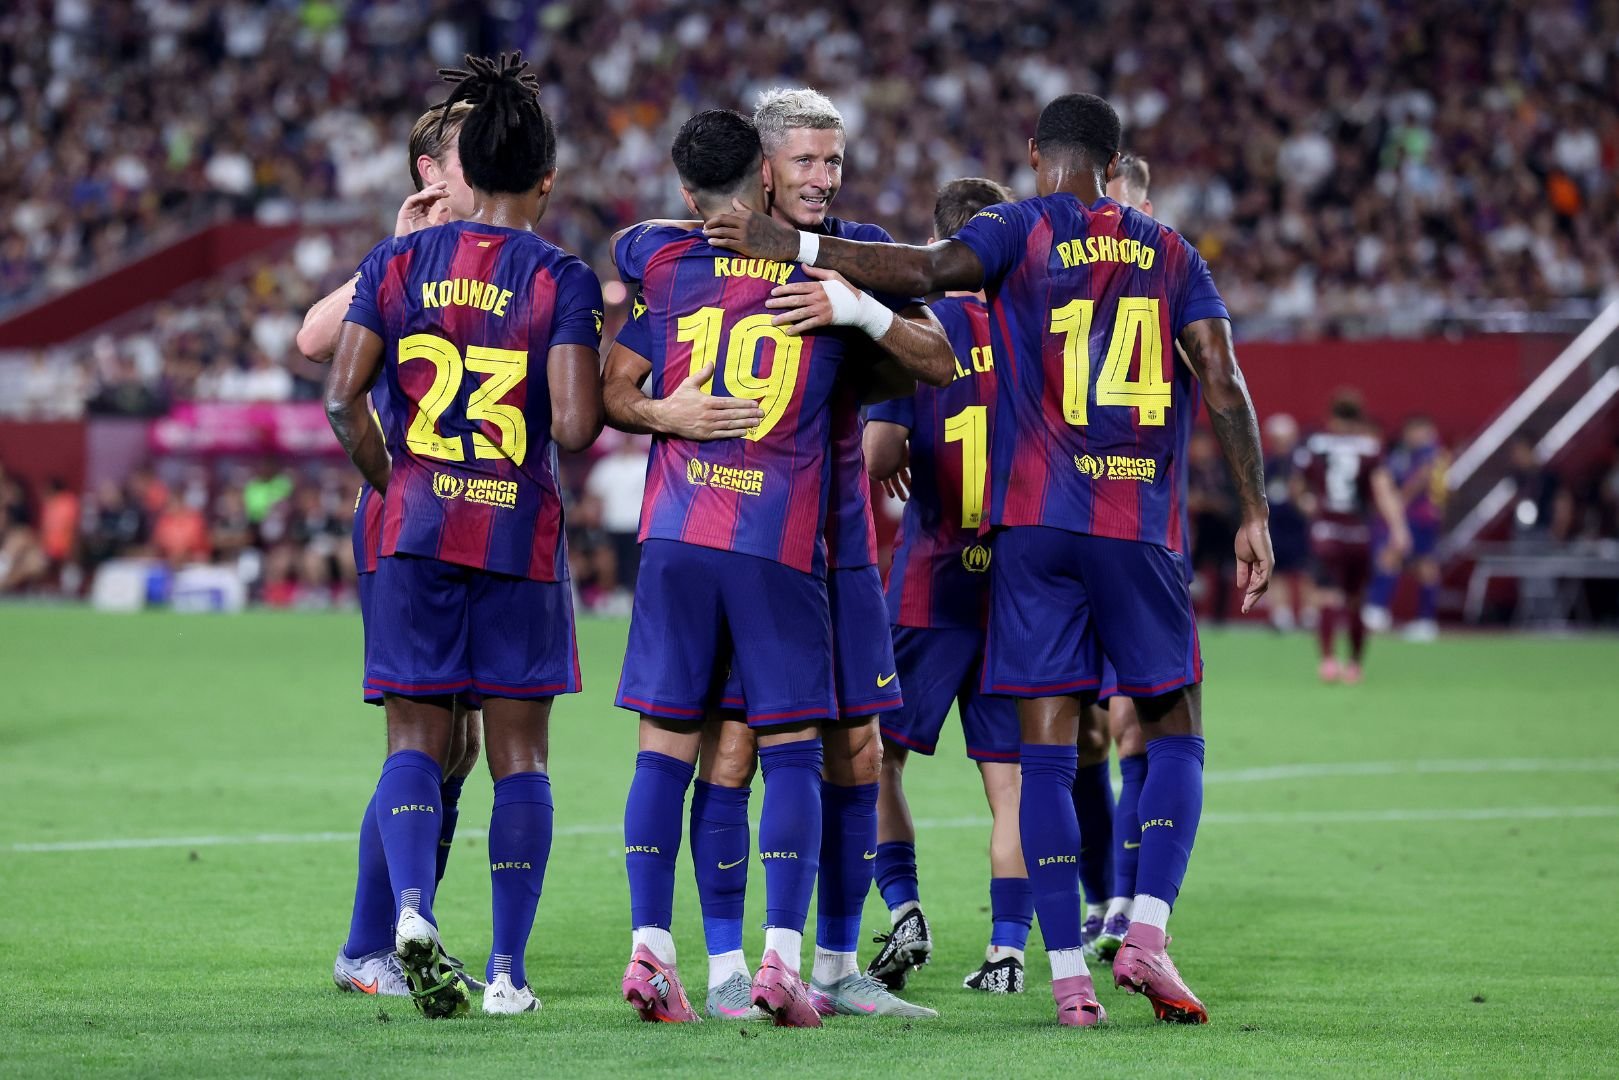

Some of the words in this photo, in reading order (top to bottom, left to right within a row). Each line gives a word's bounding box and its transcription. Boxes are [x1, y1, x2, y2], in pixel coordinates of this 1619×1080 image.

[1056, 235, 1155, 270] RASHFORD
[423, 278, 513, 317] KOUNDE
[677, 306, 803, 441] 19
[1050, 297, 1172, 426] 14
[398, 333, 528, 466] 23
[713, 463, 764, 481] UNHCR
[944, 405, 987, 528] 1
[1106, 456, 1156, 468] UNHCR
[1107, 467, 1155, 478] ACNUR
[467, 478, 518, 493] UNHCR
[710, 474, 762, 492] ACNUR
[464, 489, 516, 504] ACNUR
